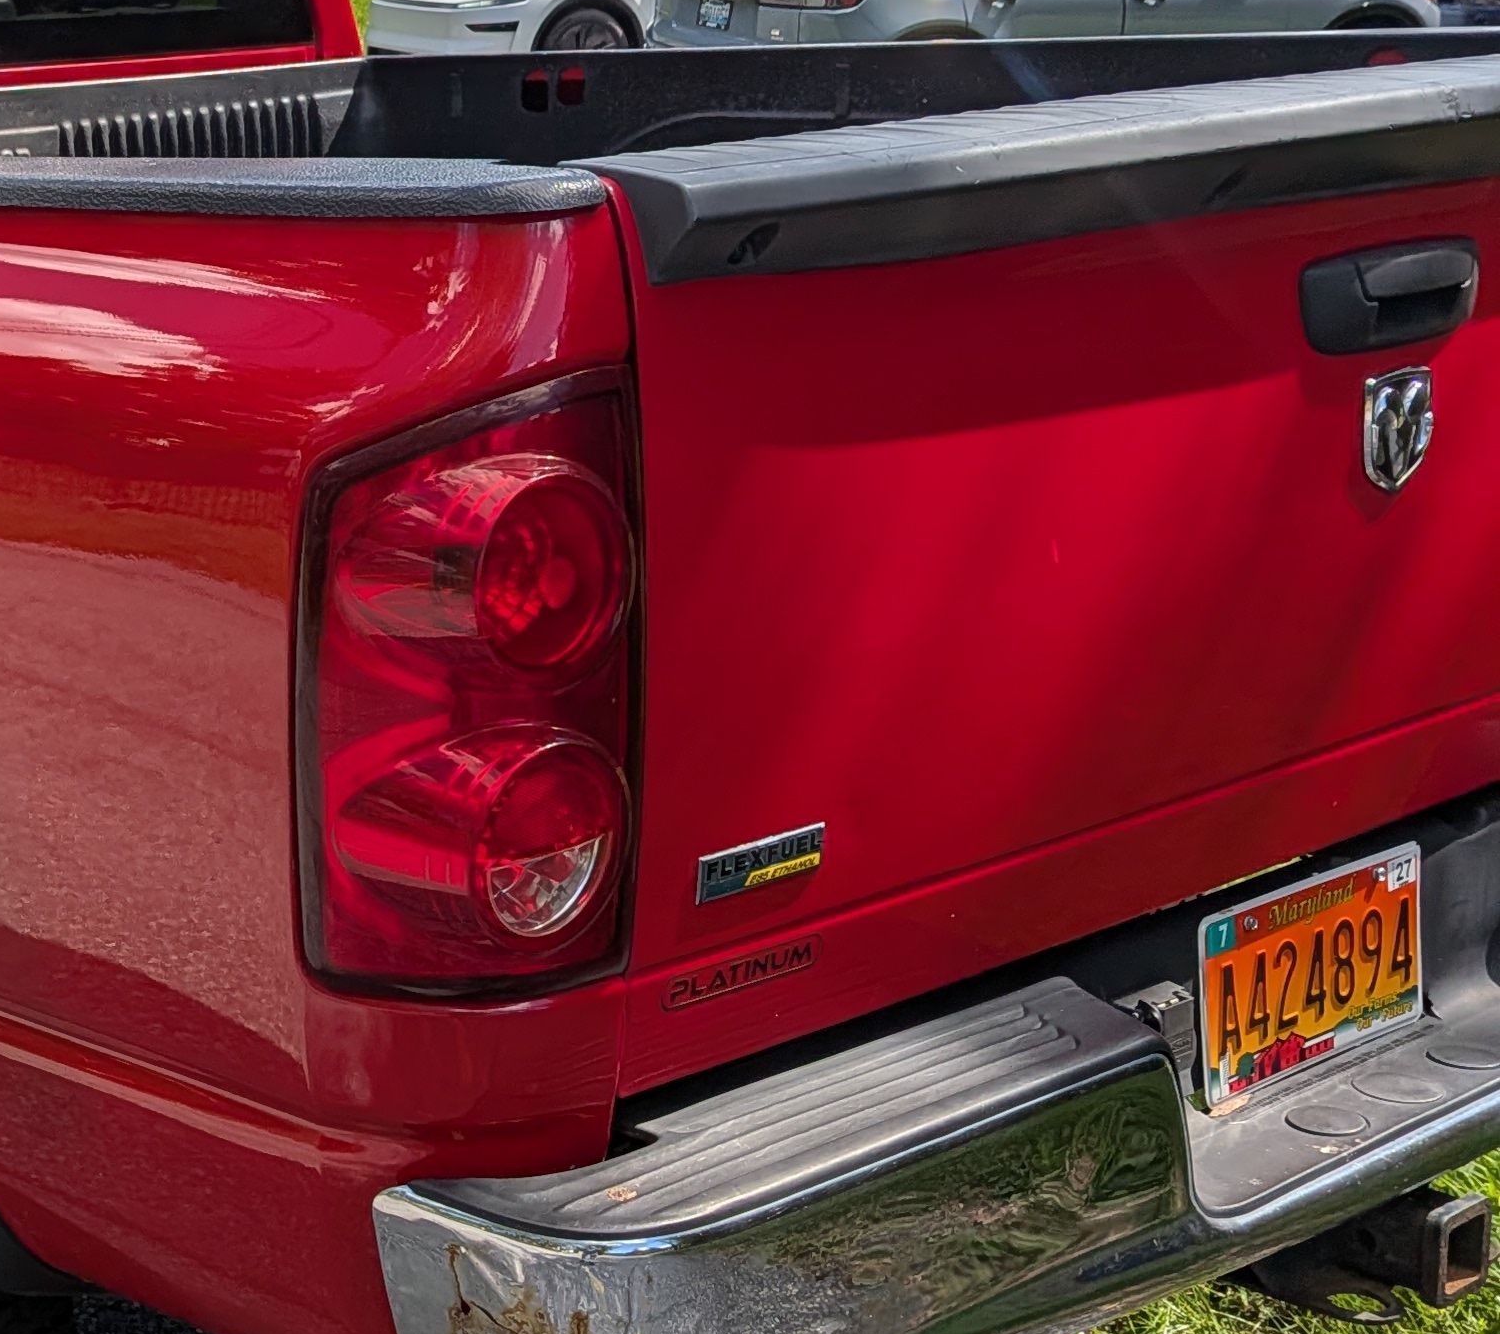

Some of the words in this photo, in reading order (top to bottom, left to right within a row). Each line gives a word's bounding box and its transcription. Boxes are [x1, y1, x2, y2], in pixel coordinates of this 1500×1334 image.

[705, 831, 822, 882] FLEXFUEL
[750, 870, 771, 885] E85
[771, 856, 816, 878] ETHANOL
[1394, 859, 1413, 883] 27
[1269, 875, 1356, 930] Maryland
[1217, 922, 1230, 949] 7
[668, 941, 813, 1004] PLATINUM
[1219, 896, 1413, 1054] A424894
[1348, 1005, 1363, 1019] Our
[1356, 1016, 1372, 1032] Our
[1379, 1000, 1413, 1023] Future
